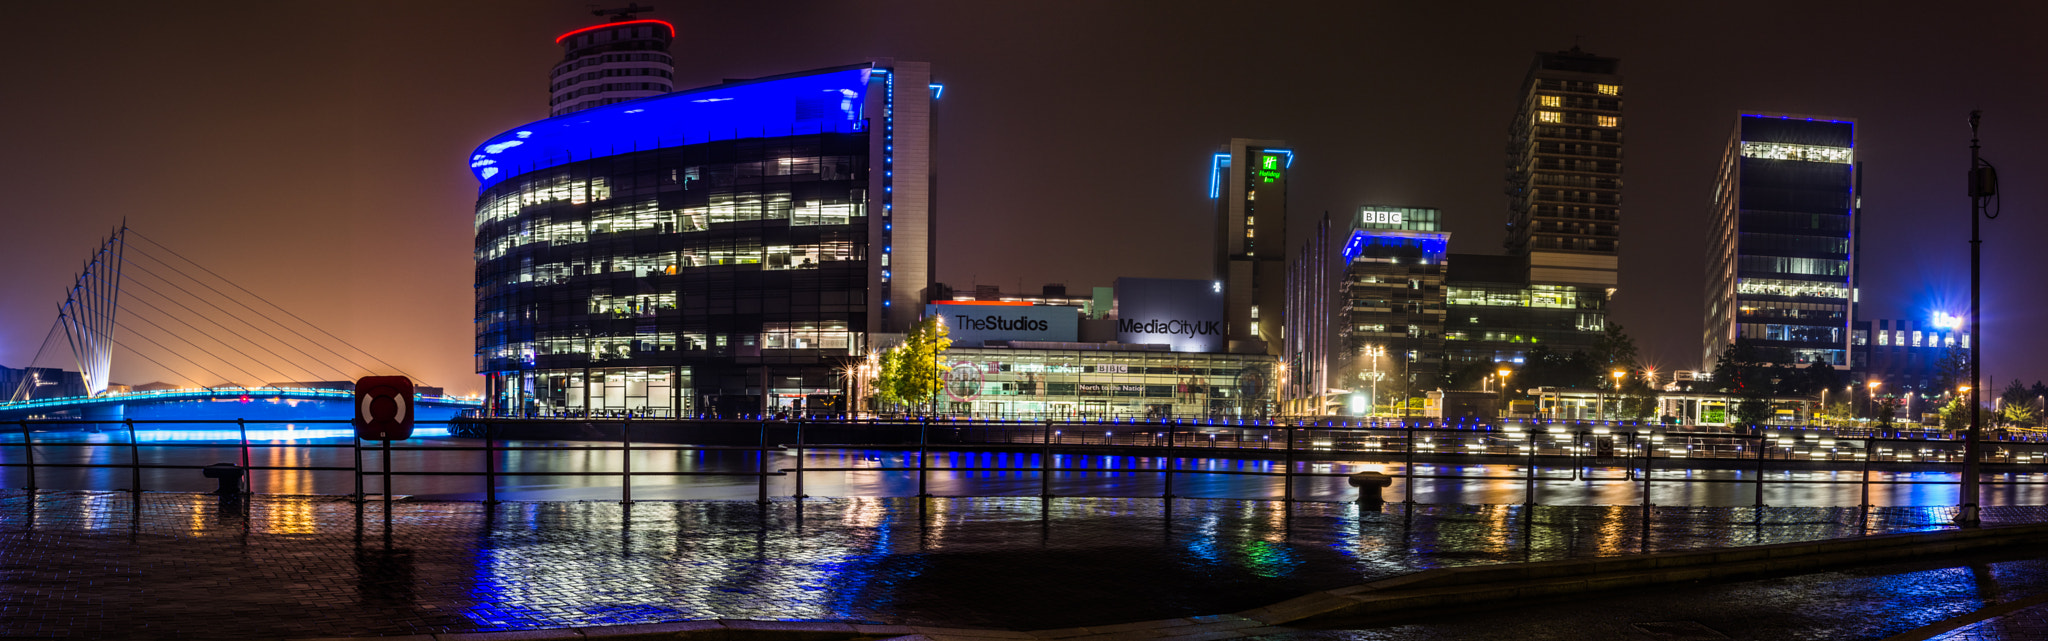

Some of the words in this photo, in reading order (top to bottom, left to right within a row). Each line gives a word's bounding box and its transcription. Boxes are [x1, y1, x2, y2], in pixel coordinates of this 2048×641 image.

[1259, 170, 1280, 178] Holiday
[1365, 212, 1400, 223] BBC
[955, 314, 1048, 331] TheStudios
[1119, 318, 1220, 339] MediaCityUK
[1098, 364, 1127, 373] BBC
